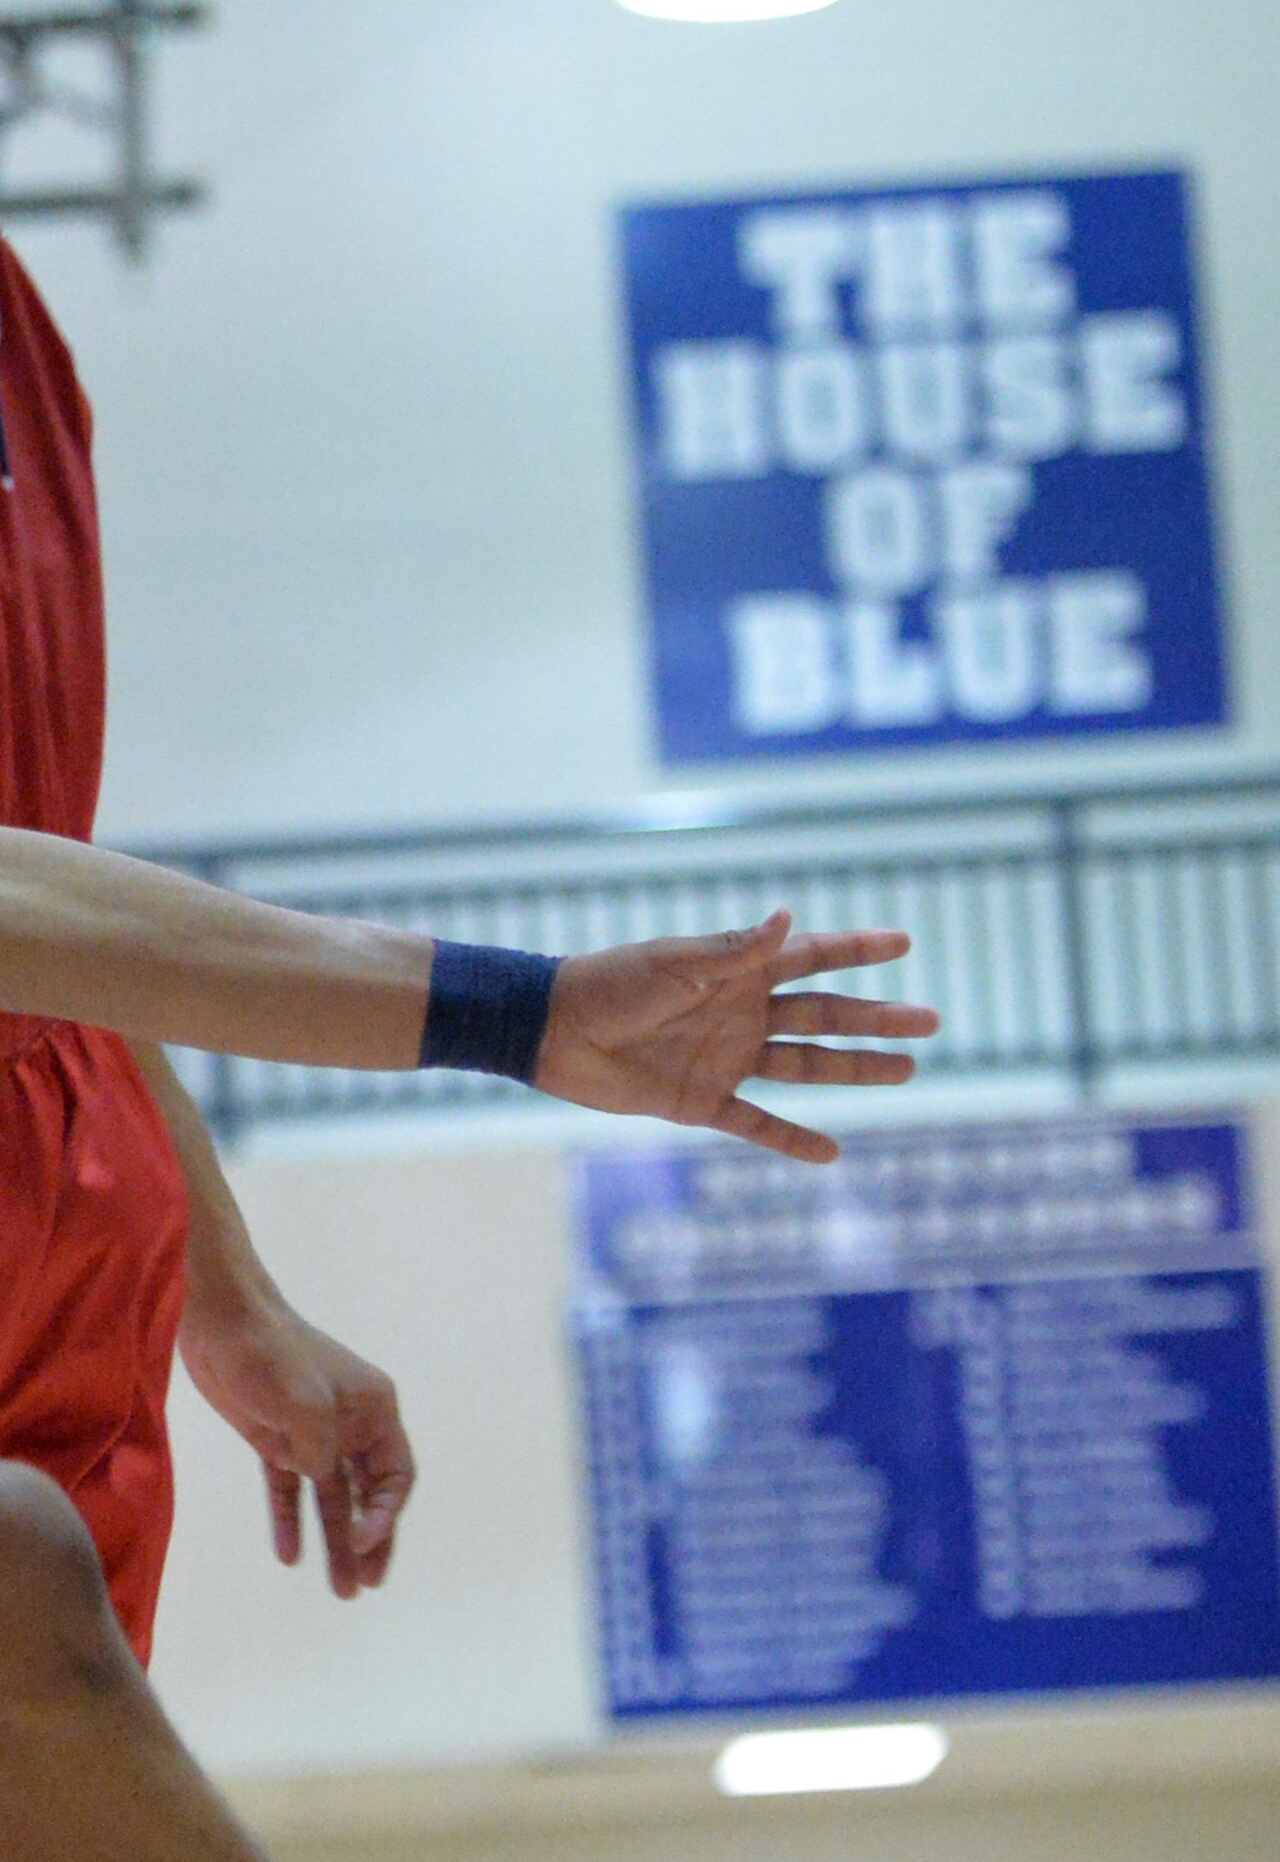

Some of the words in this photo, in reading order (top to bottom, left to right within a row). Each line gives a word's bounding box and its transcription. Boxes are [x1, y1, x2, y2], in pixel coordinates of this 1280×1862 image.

[742, 190, 1072, 333] THE
[658, 309, 1184, 481] HOUSE
[828, 462, 1032, 599] OF
[734, 569, 1152, 734] BLUE
